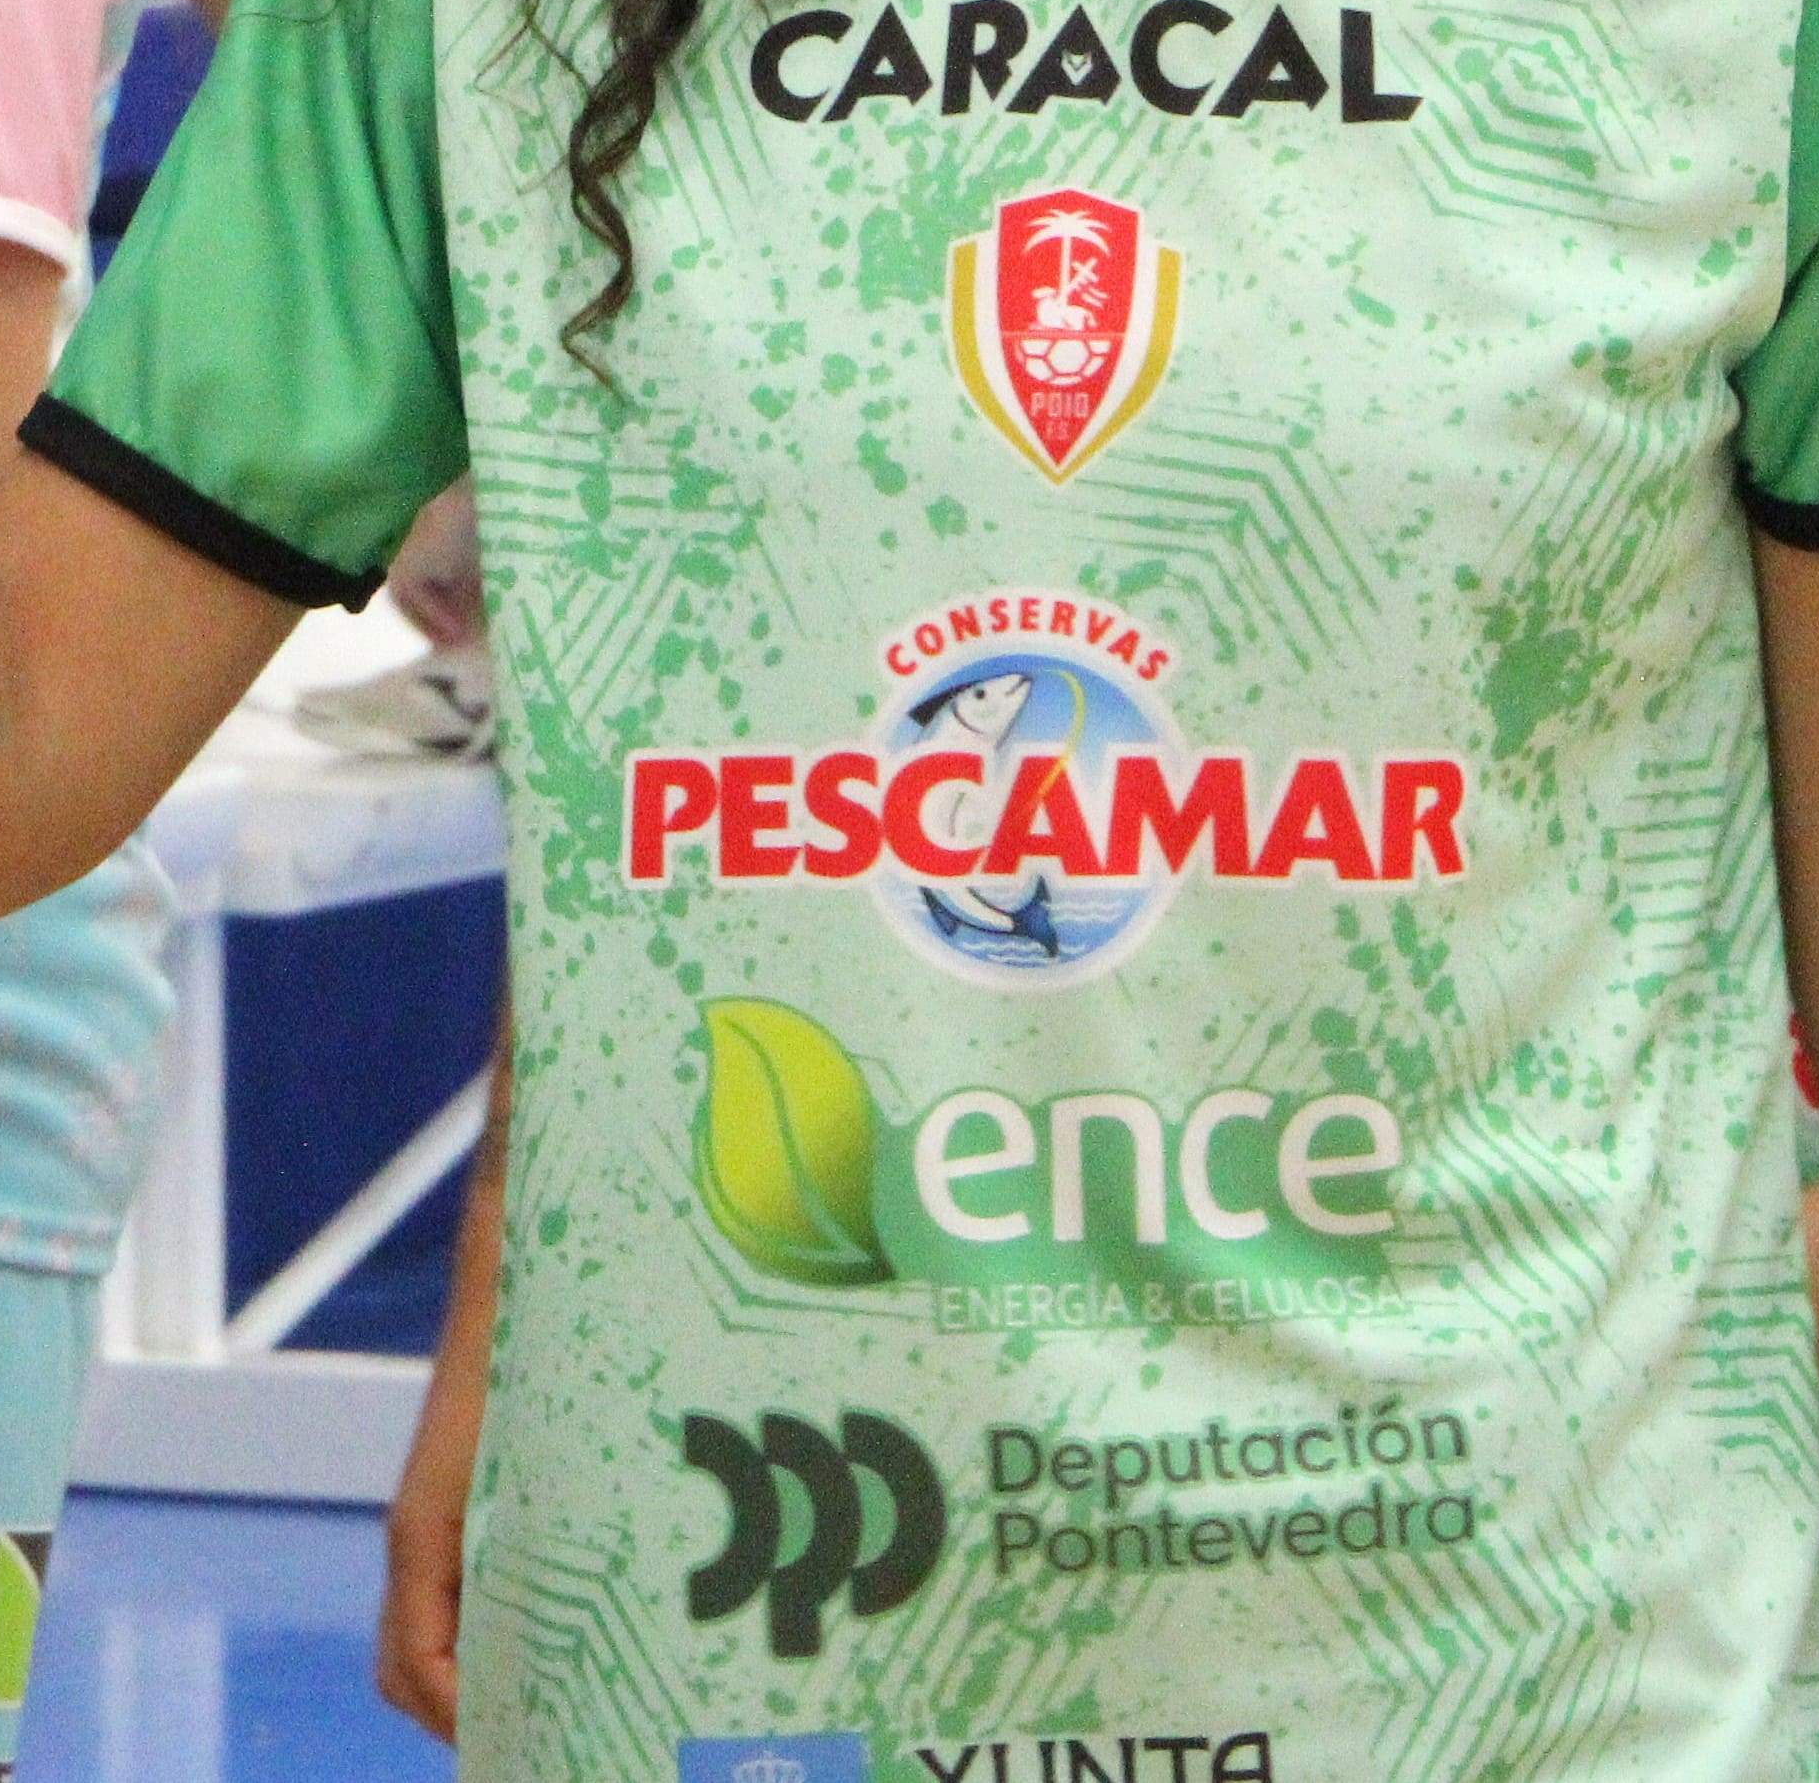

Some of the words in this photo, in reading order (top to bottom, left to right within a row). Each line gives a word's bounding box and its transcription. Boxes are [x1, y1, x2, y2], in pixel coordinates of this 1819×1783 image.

[884, 597, 1170, 681] CONSERVAS
[629, 754, 1465, 881] PESCAMAR
[913, 1088, 1404, 1244] ence
[942, 1273, 1129, 1330] ENERGÍA
[1143, 1283, 1171, 1321] &
[988, 1399, 1469, 1509] Deputación
[991, 1480, 1476, 1577] Pontevedra
